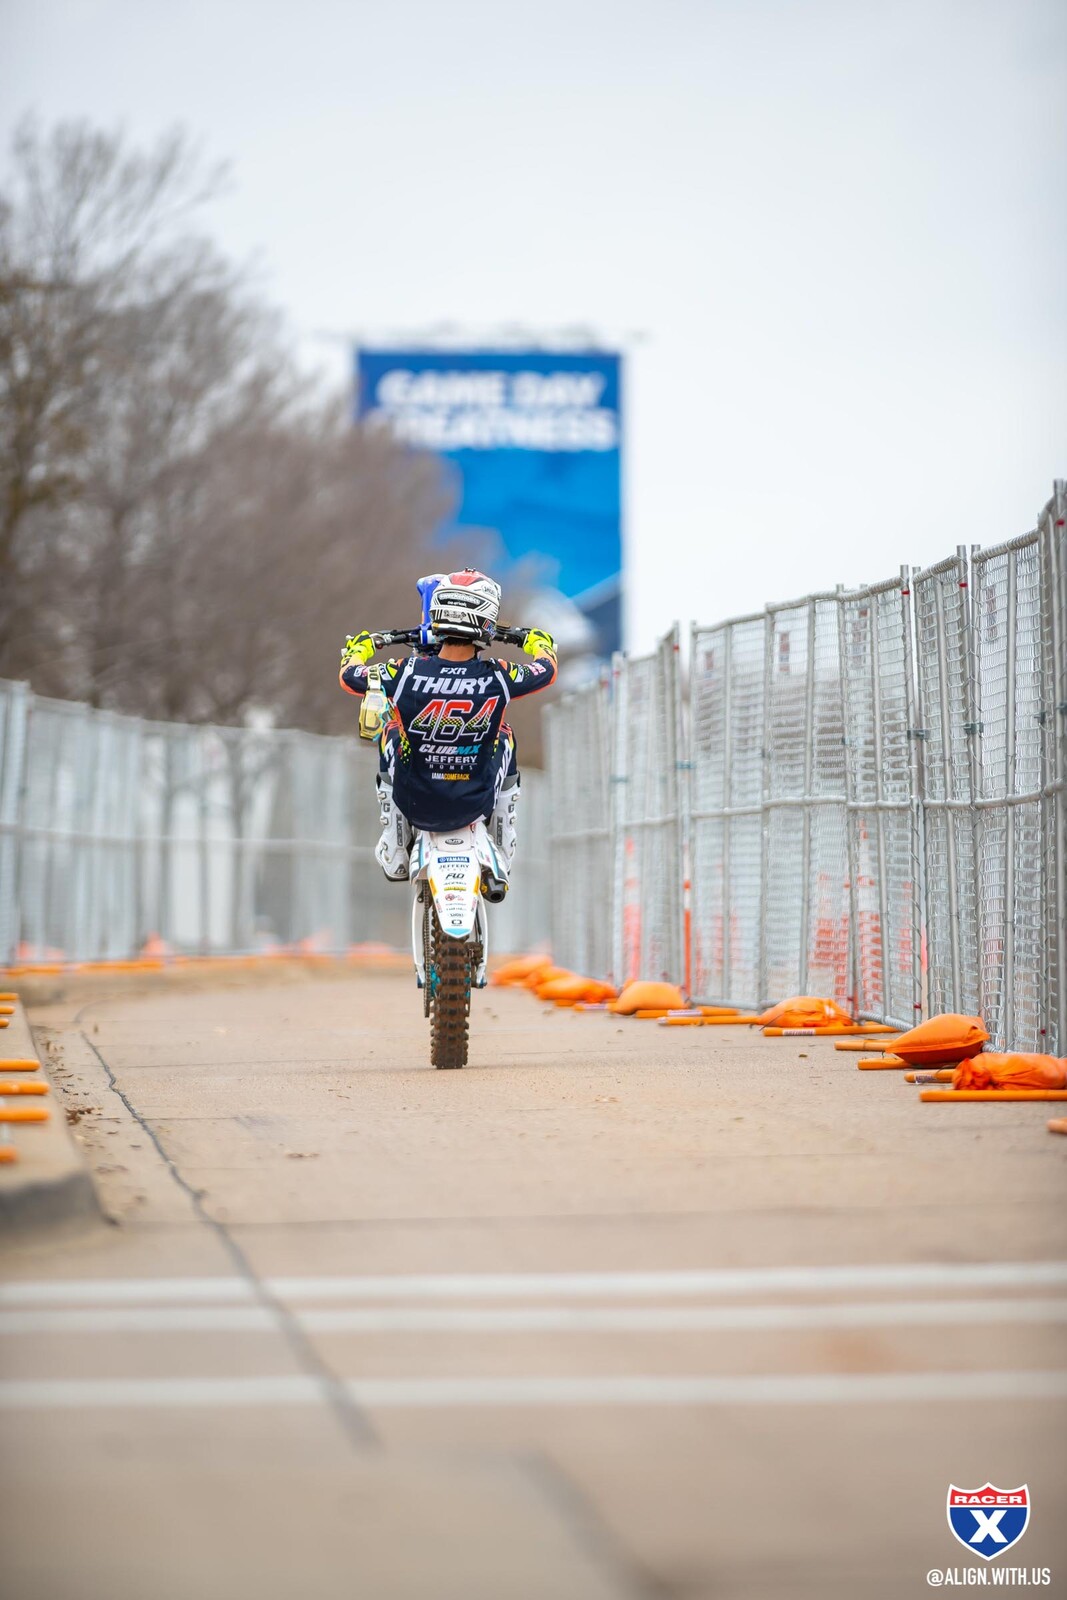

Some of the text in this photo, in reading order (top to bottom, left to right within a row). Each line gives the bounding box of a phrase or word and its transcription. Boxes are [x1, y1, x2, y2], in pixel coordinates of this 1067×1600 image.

[376, 369, 607, 407] GAME DAY
[440, 667, 467, 675] FXR
[412, 675, 494, 695] THURY
[408, 695, 500, 743] 464
[418, 744, 482, 755] CLUBMX
[425, 755, 478, 764] JEFFERY
